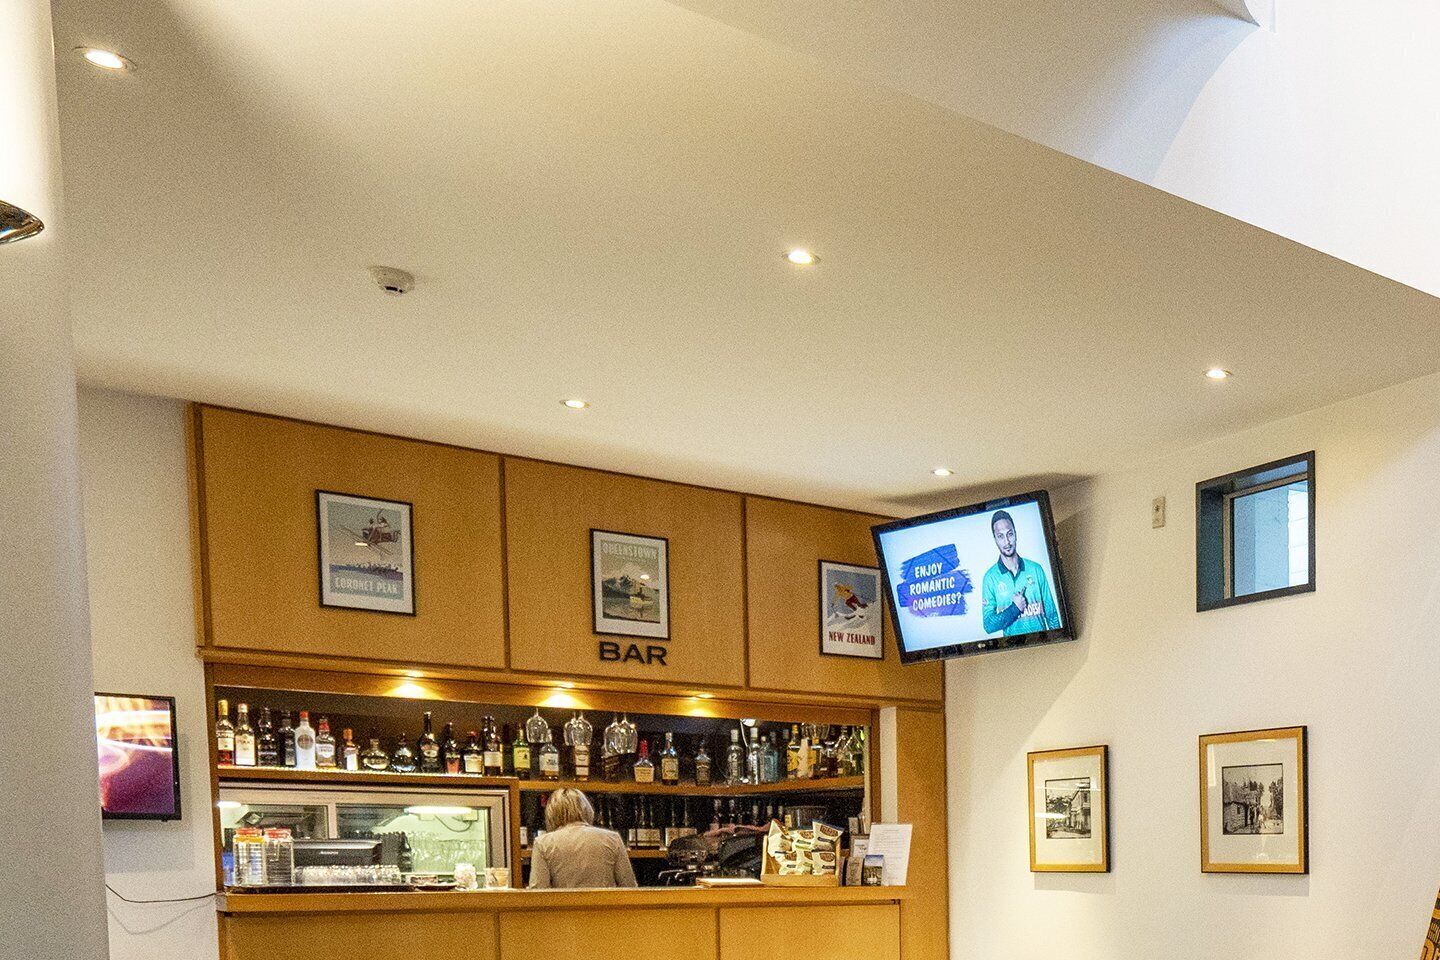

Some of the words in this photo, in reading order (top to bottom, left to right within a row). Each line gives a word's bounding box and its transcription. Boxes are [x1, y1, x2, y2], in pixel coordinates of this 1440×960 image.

[914, 562, 943, 579] ENJOY
[335, 577, 373, 592] CORONET
[376, 580, 398, 594] PEAK
[909, 576, 955, 596] ROMANTIC
[912, 592, 962, 611] COMEDIES?
[829, 631, 844, 642] NEW
[847, 633, 876, 645] ZEALAND
[599, 641, 667, 666] BAR
